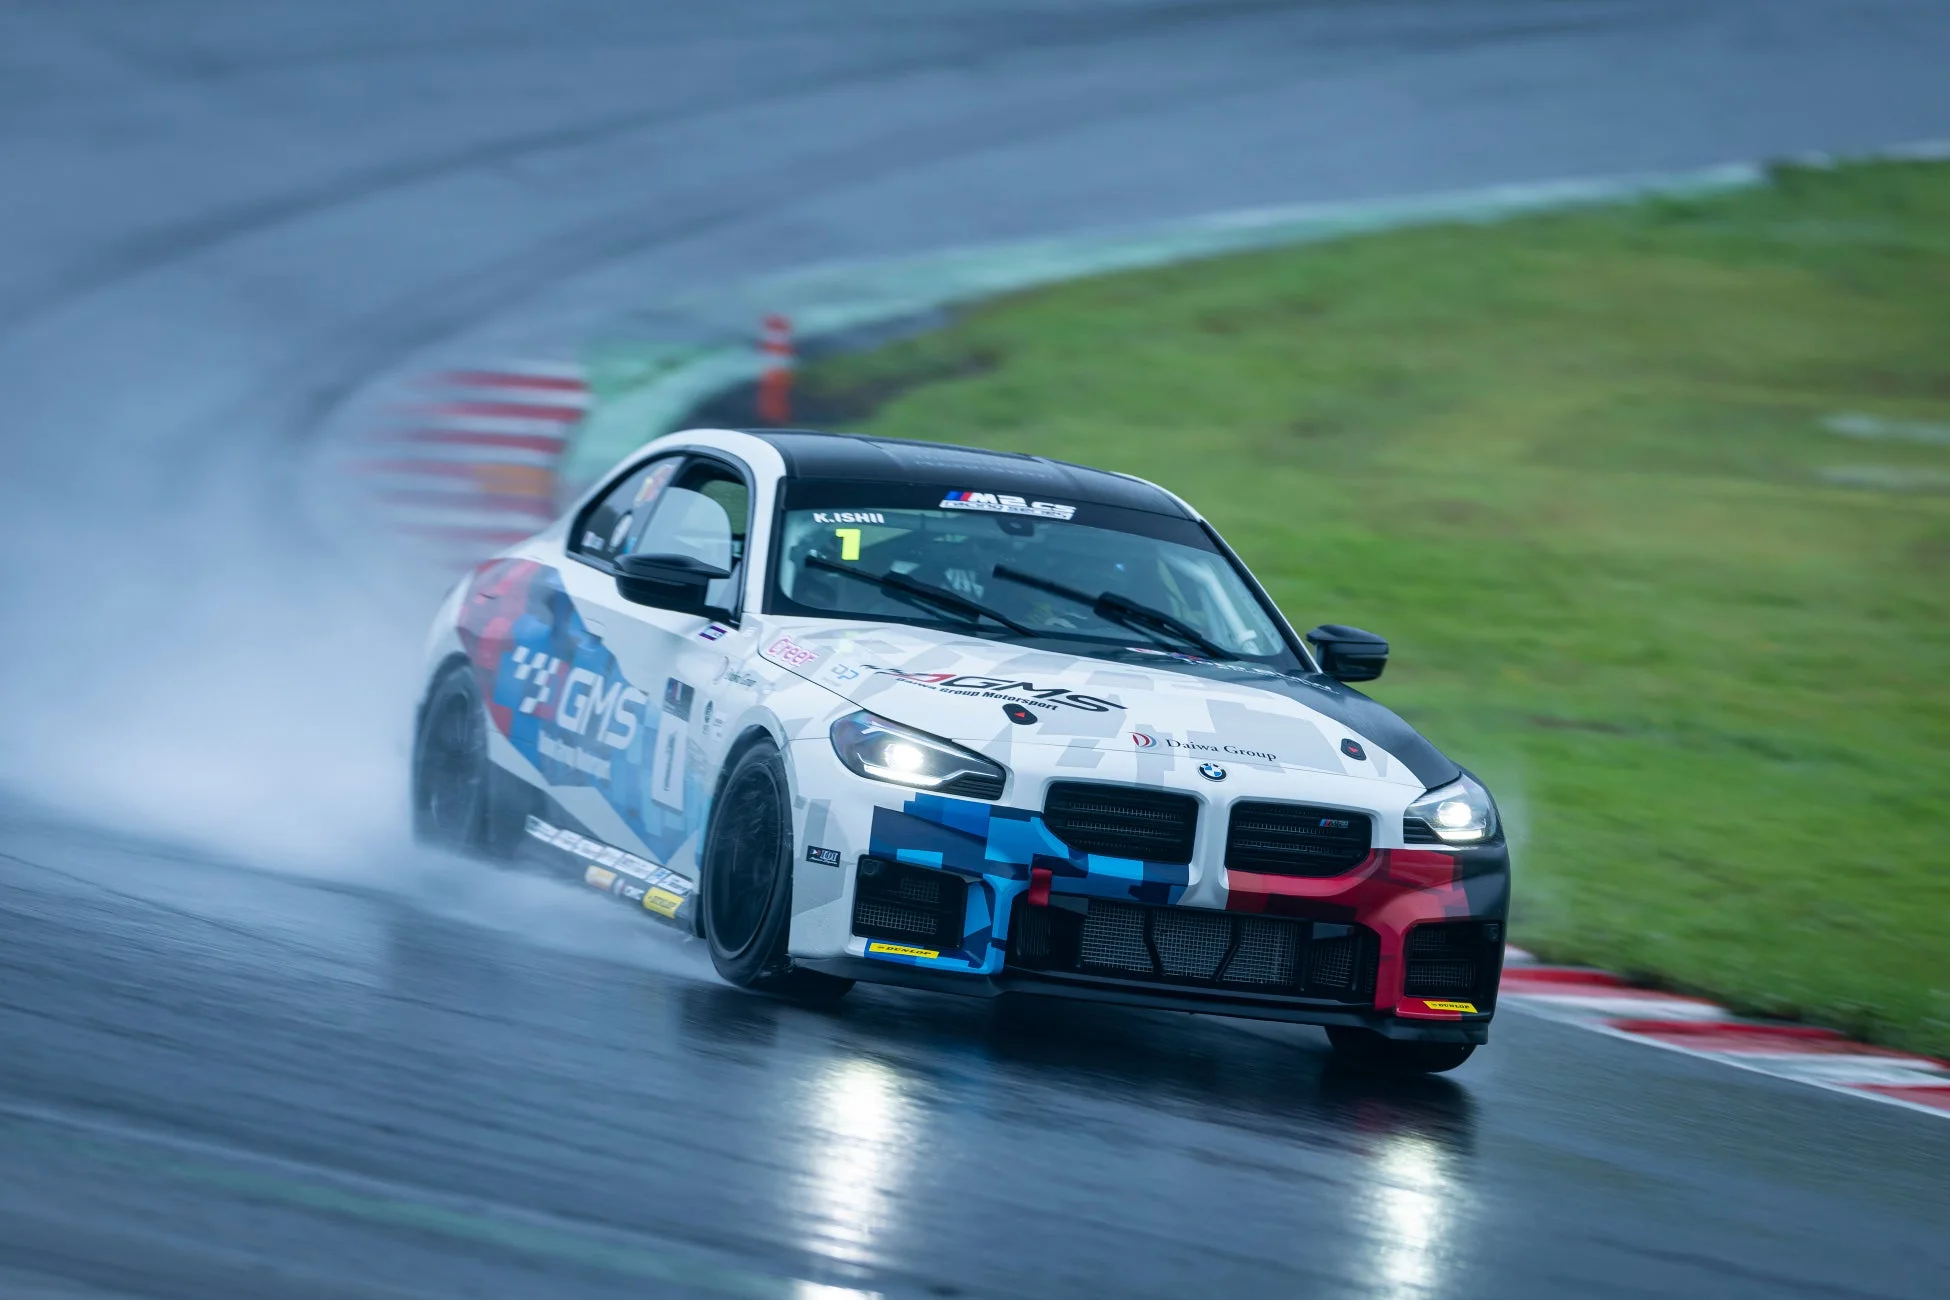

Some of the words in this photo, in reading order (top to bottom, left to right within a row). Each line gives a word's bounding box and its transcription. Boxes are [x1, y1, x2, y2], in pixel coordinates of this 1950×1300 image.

[812, 512, 885, 523] K.ISHII
[835, 528, 861, 561] 1
[939, 675, 1129, 713] GMS
[940, 688, 980, 697] Group
[982, 691, 1058, 711] Motorsport
[556, 667, 648, 750] GMS
[1165, 738, 1218, 752] Daiwa
[1223, 745, 1277, 762] Group
[886, 946, 932, 955] DUNLOP
